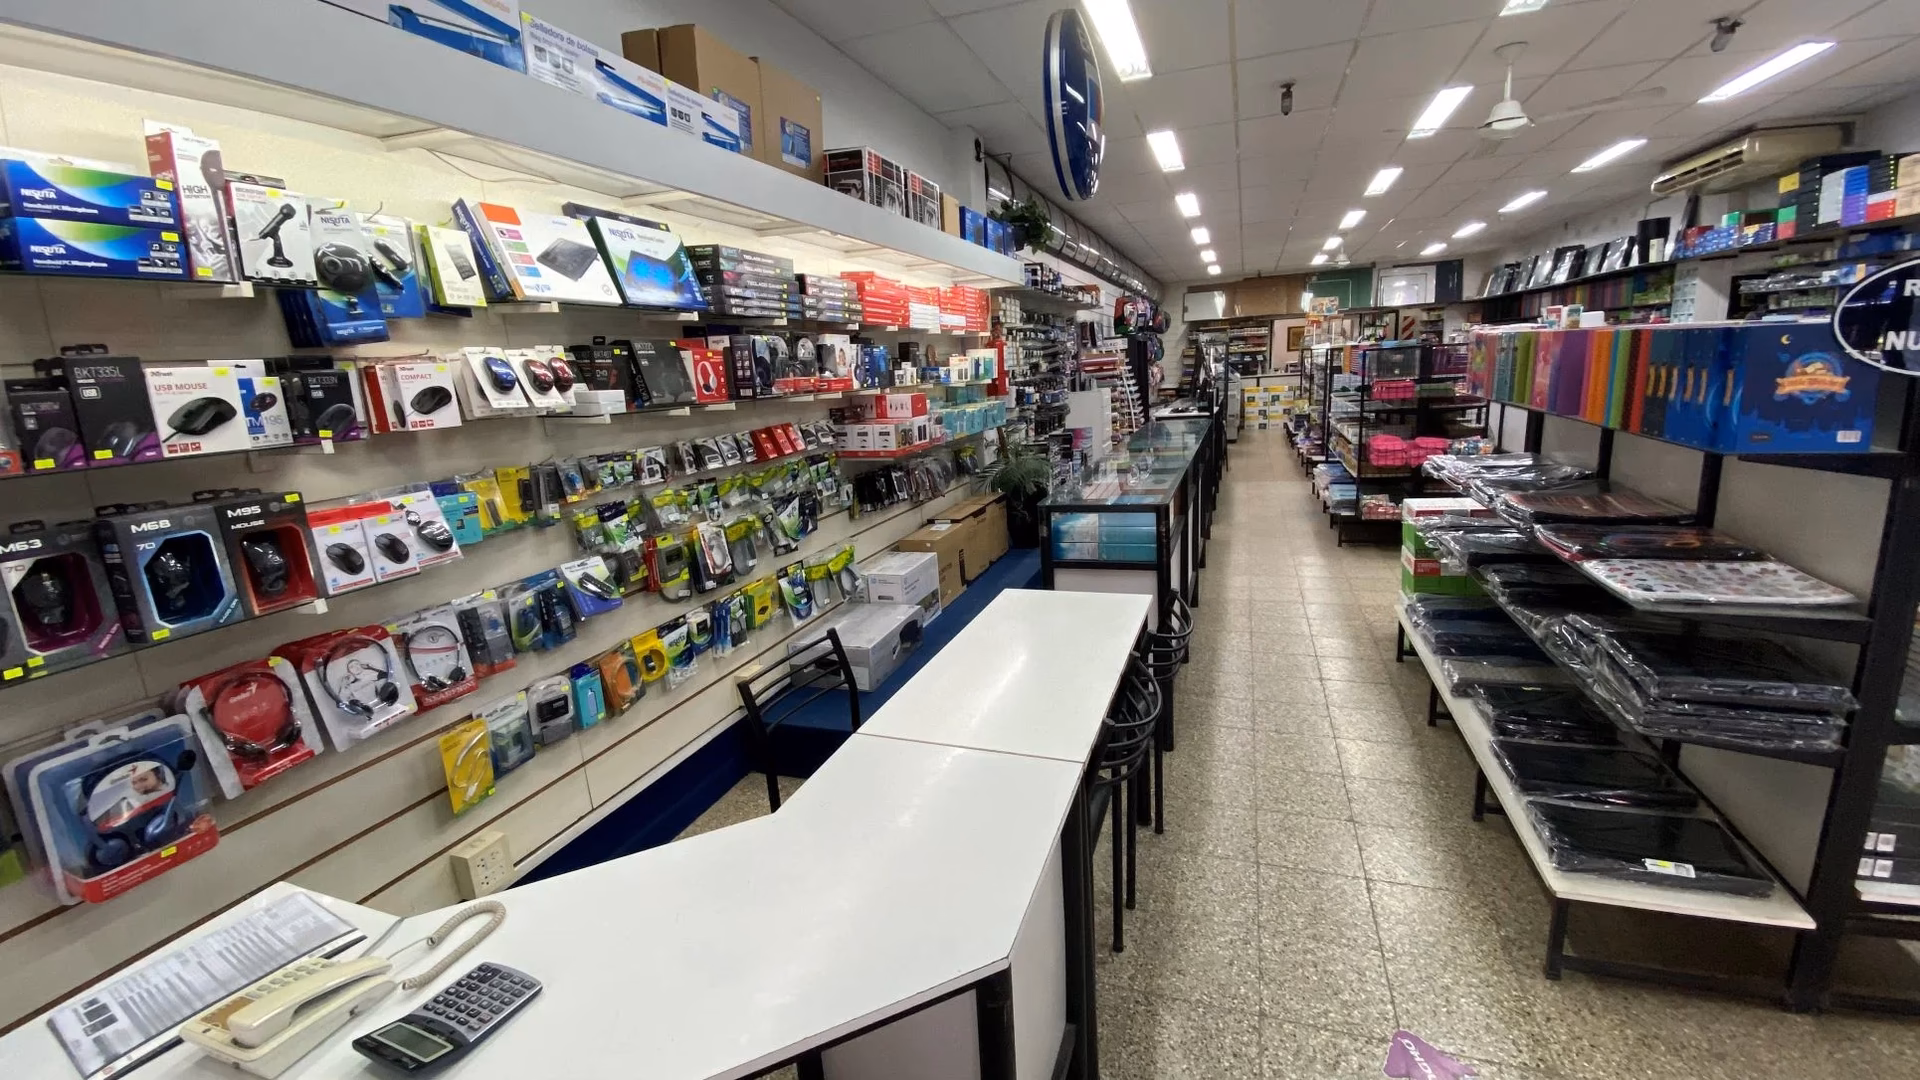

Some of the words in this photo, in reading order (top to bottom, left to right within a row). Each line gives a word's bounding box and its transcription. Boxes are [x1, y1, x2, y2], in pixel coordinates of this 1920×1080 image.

[20, 188, 57, 201] NISUTA
[182, 185, 209, 194] HIGH
[320, 215, 351, 226] NISUTA
[608, 227, 636, 242] NISUTA
[30, 243, 67, 257] NISUTA
[400, 373, 432, 381] COMPACT
[154, 383, 173, 392] USB
[174, 382, 208, 391] MOUSE
[226, 505, 262, 518] M95
[130, 519, 172, 534] M68
[231, 519, 265, 530] MOUSE
[0, 538, 43, 555] M63
